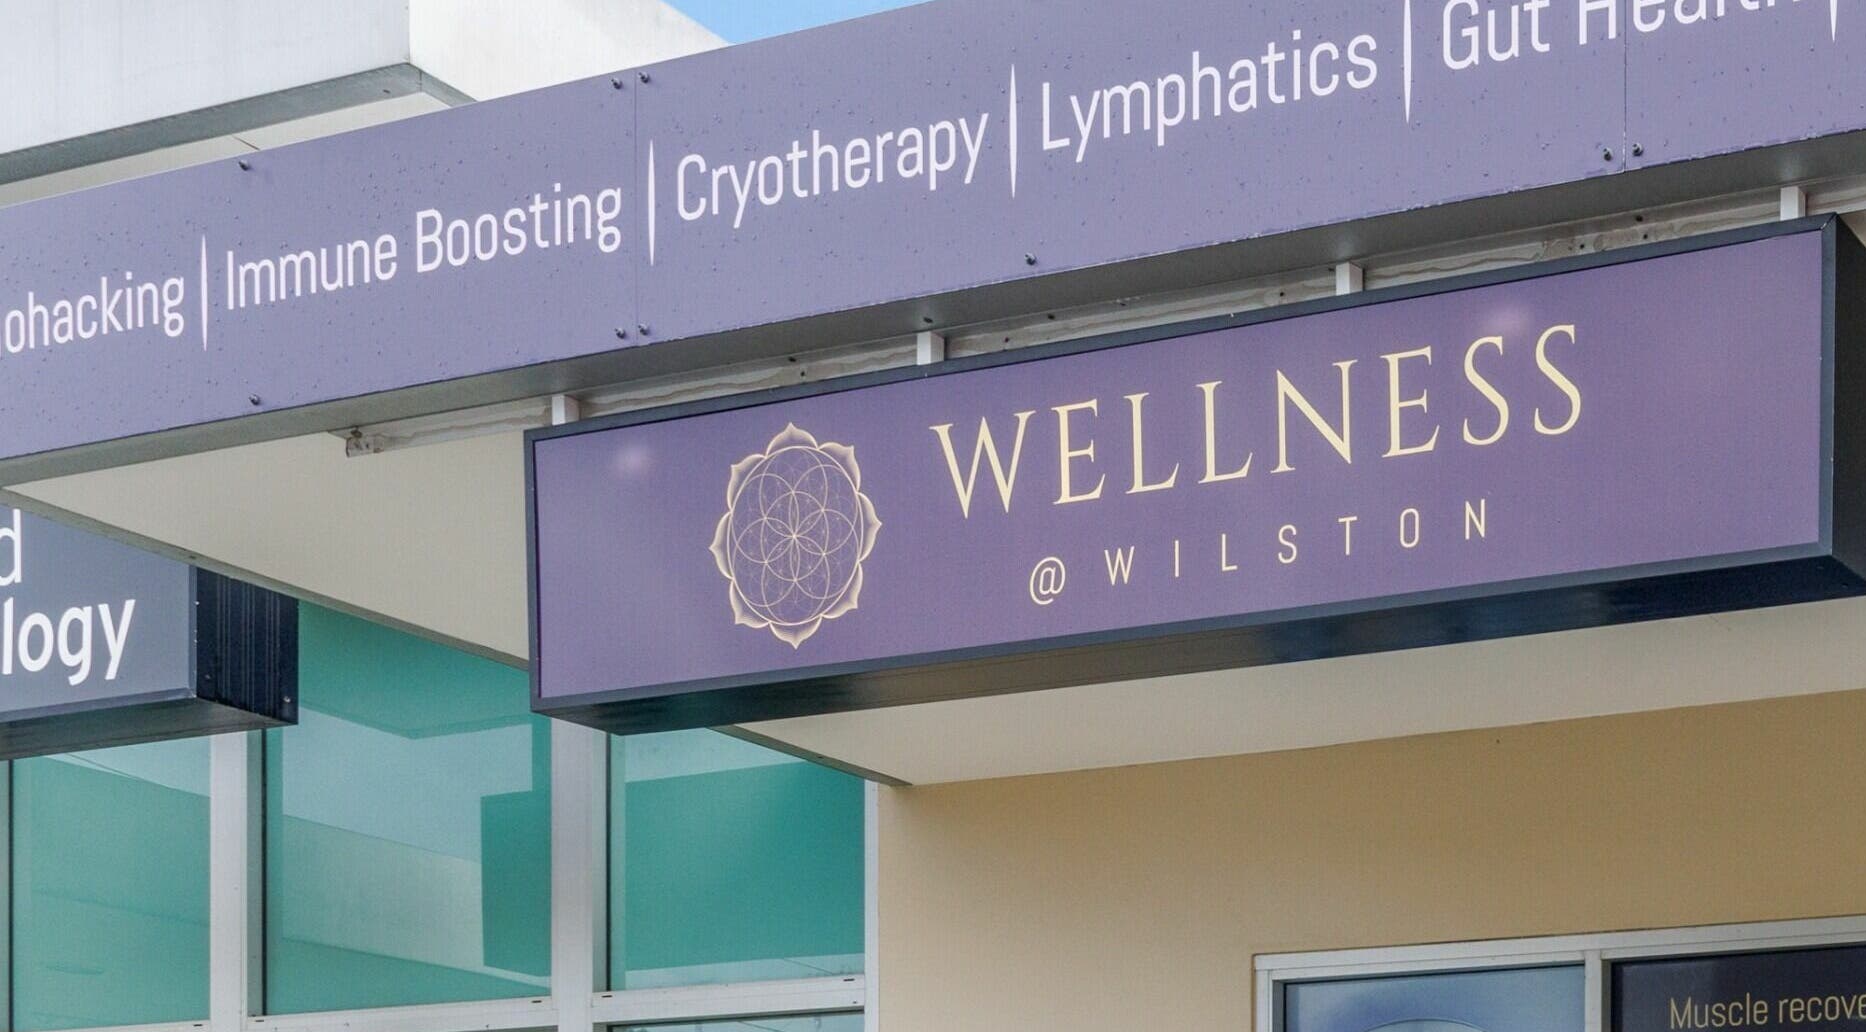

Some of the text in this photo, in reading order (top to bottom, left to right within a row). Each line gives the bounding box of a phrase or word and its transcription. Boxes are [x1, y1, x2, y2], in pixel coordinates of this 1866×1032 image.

[5, 272, 184, 354] ohacking
[226, 232, 397, 311] Immune
[416, 183, 622, 272] Boosting
[676, 112, 988, 229] Cryotherapy
[1042, 30, 1378, 162] Lymphatics
[1443, 0, 1551, 70] Gut
[929, 324, 1583, 520] WELLNESS
[1028, 498, 1488, 606] @ WILSTON
[1, 597, 136, 687] logy
[1669, 992, 1769, 1030] Muscle
